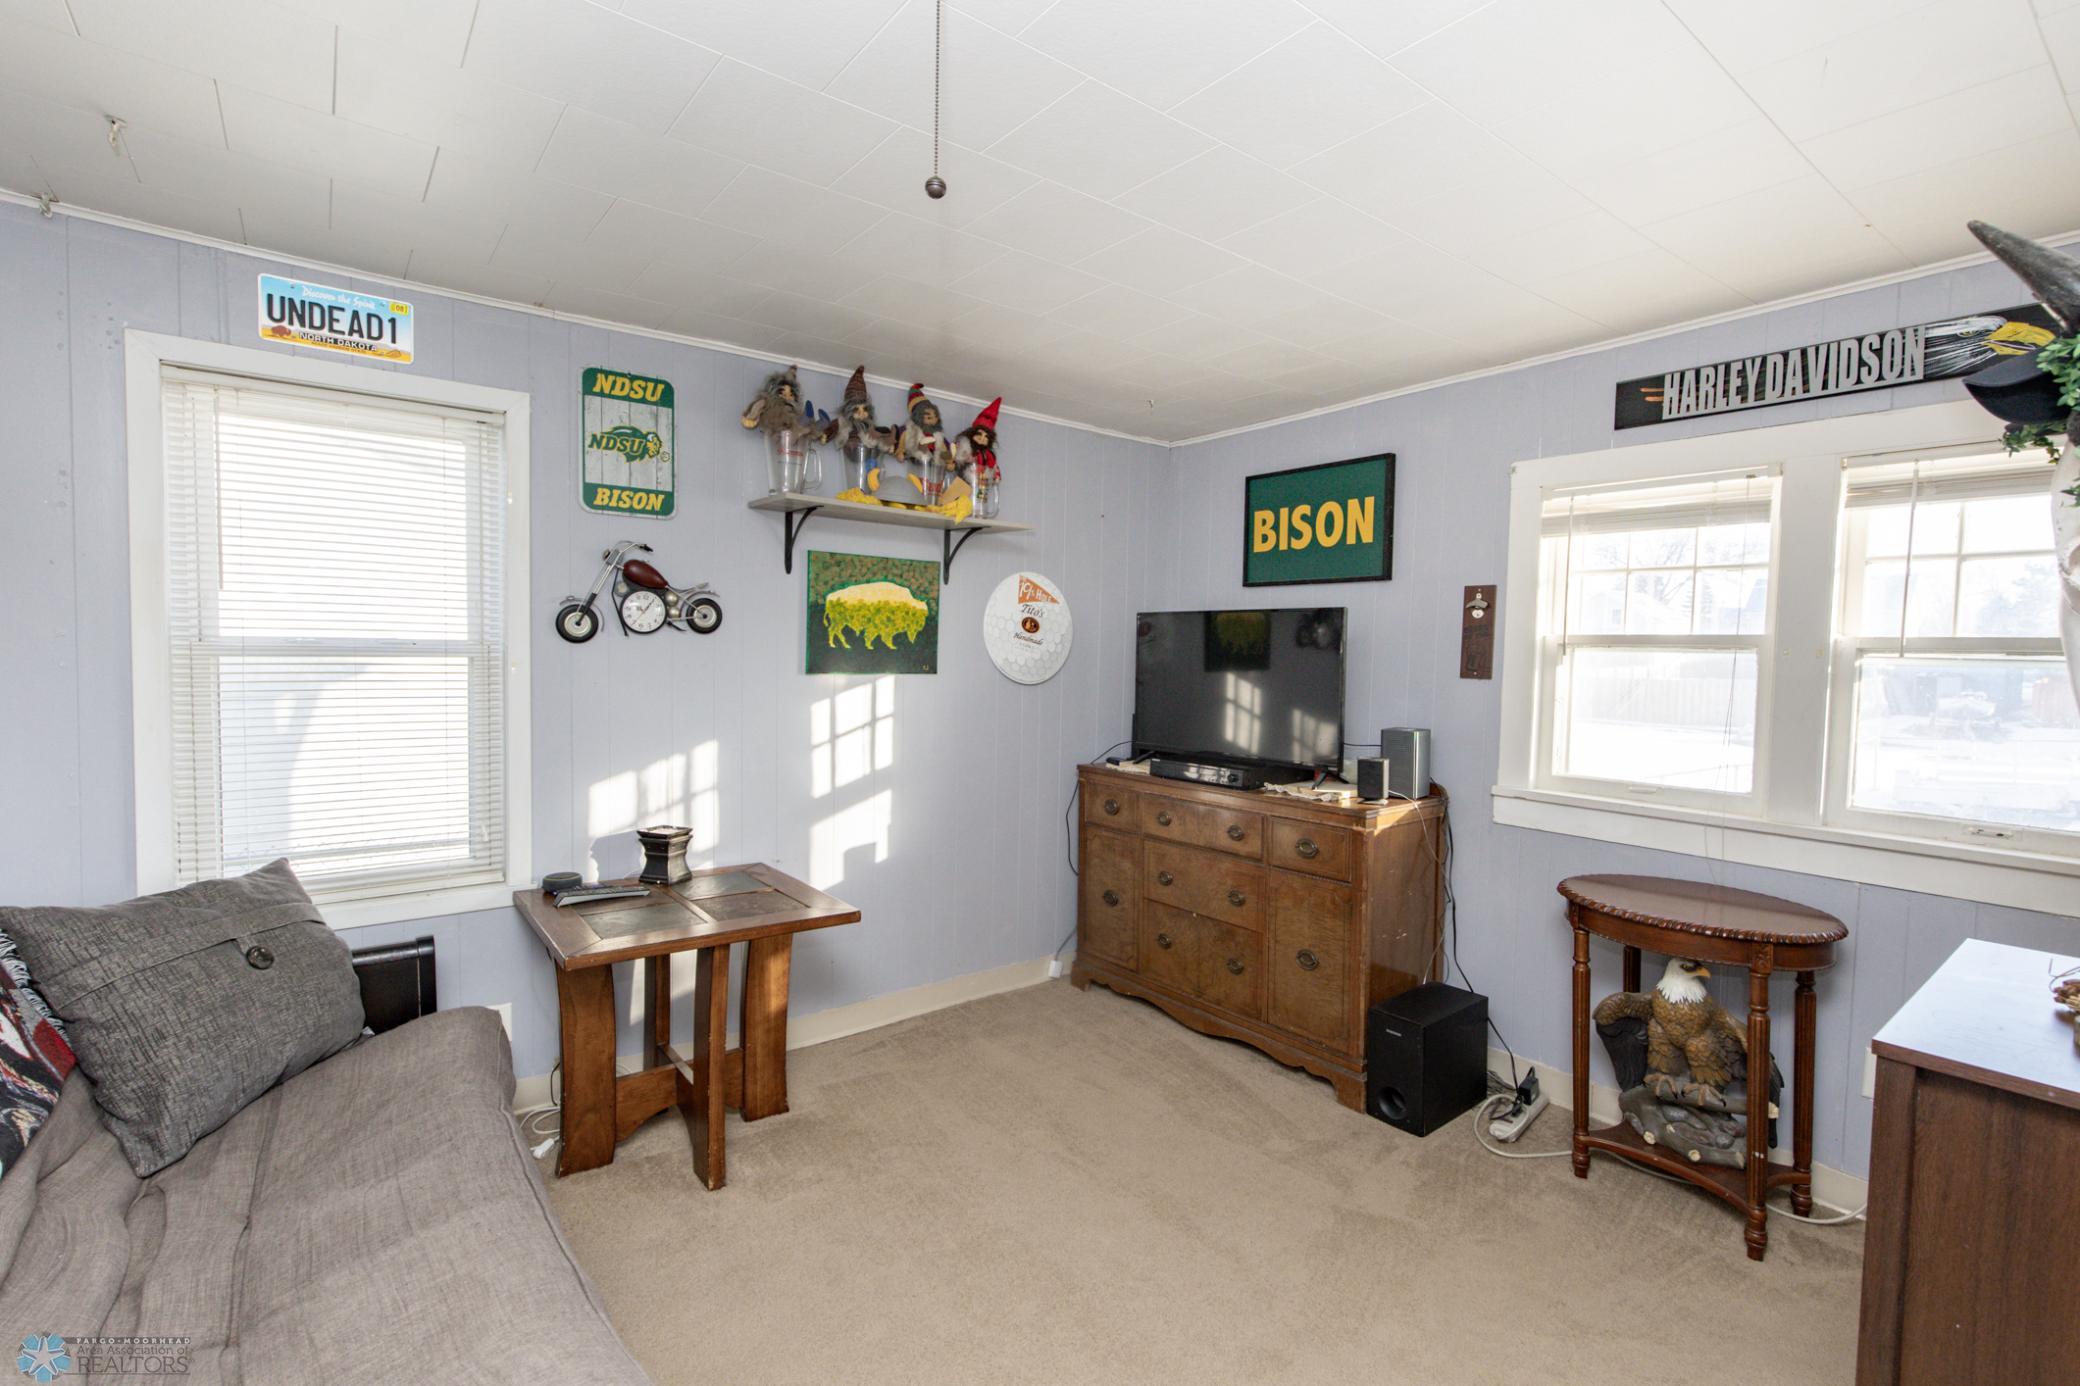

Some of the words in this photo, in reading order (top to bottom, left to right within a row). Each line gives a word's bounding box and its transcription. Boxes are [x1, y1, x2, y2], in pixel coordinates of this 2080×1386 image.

[267, 293, 397, 344] UNDEAD1
[300, 332, 334, 345] NORTH
[337, 339, 377, 352] DAKOTA
[593, 373, 665, 402] NDSU
[588, 432, 646, 455] NDSU
[593, 487, 665, 511] BISON
[1253, 496, 1375, 553] BISON
[1021, 603, 1045, 618] Tito's
